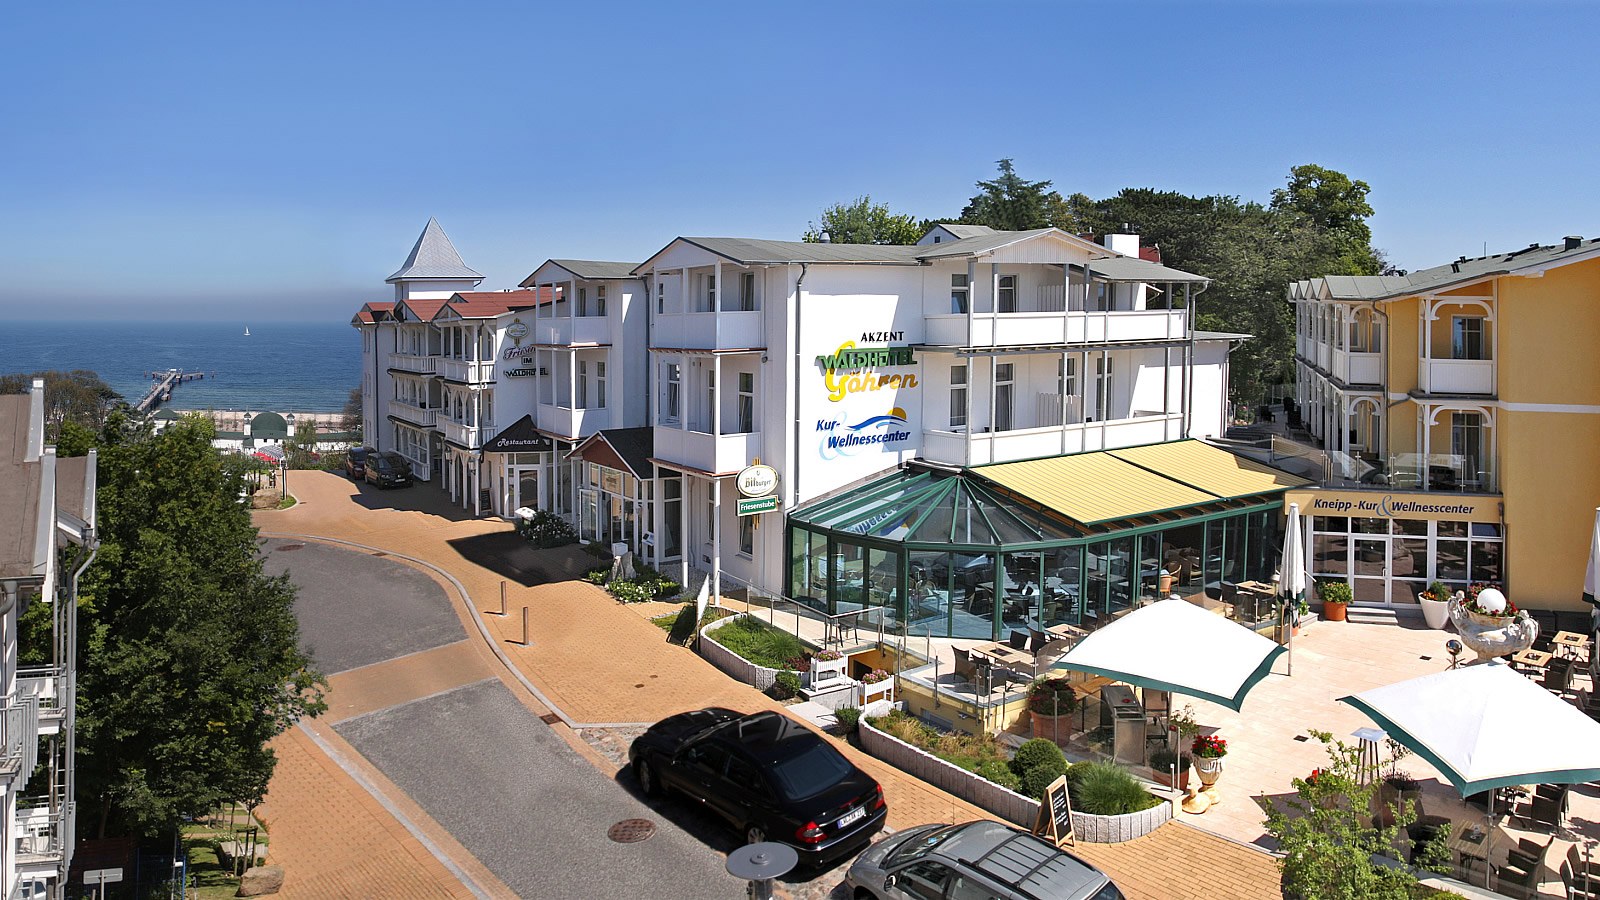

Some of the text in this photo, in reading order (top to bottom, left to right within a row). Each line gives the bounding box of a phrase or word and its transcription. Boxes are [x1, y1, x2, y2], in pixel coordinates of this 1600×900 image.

[860, 331, 905, 342] AKZENT
[815, 346, 917, 372] WALDHOTEL
[505, 368, 549, 378] WALDHOEL
[816, 419, 841, 432] Kur-
[497, 438, 539, 447] Restaurant
[827, 430, 911, 449] Wellnesscenter
[740, 501, 775, 511] Friesenstube
[1391, 501, 1475, 514] Wellnesscenter
